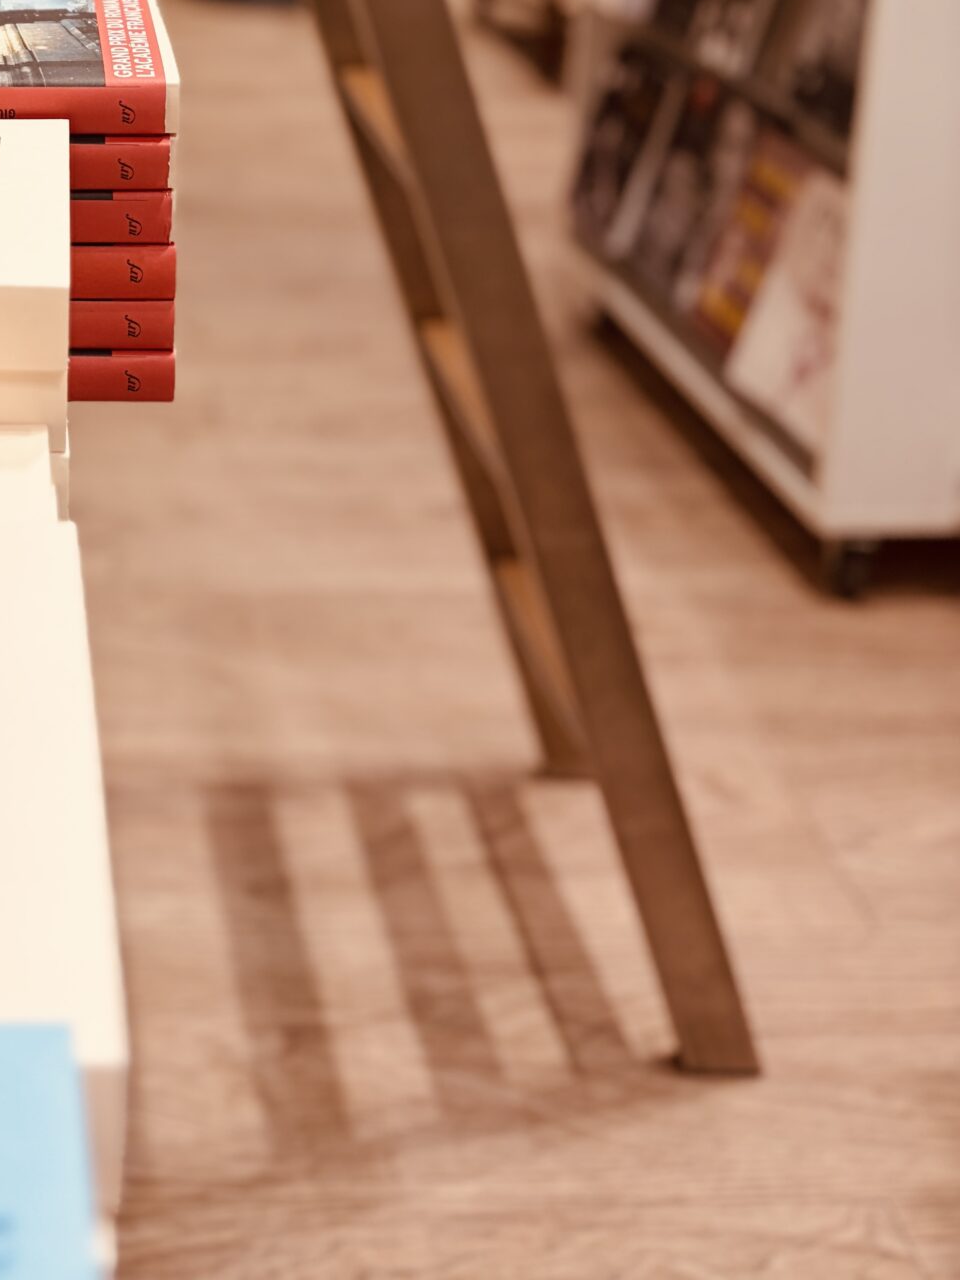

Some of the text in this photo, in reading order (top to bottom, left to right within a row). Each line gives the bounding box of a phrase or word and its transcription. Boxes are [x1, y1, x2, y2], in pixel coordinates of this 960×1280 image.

[105, 18, 124, 29] DU
[107, 28, 128, 47] PRIX
[111, 47, 133, 78] GRAND
[128, 29, 156, 78] L'ACADÉMIE
[119, 100, 136, 124] nrf
[117, 158, 135, 181] nrf
[125, 214, 143, 236] nrf
[126, 260, 143, 283] nrf
[125, 315, 141, 338] nrf
[125, 371, 141, 393] nrf
